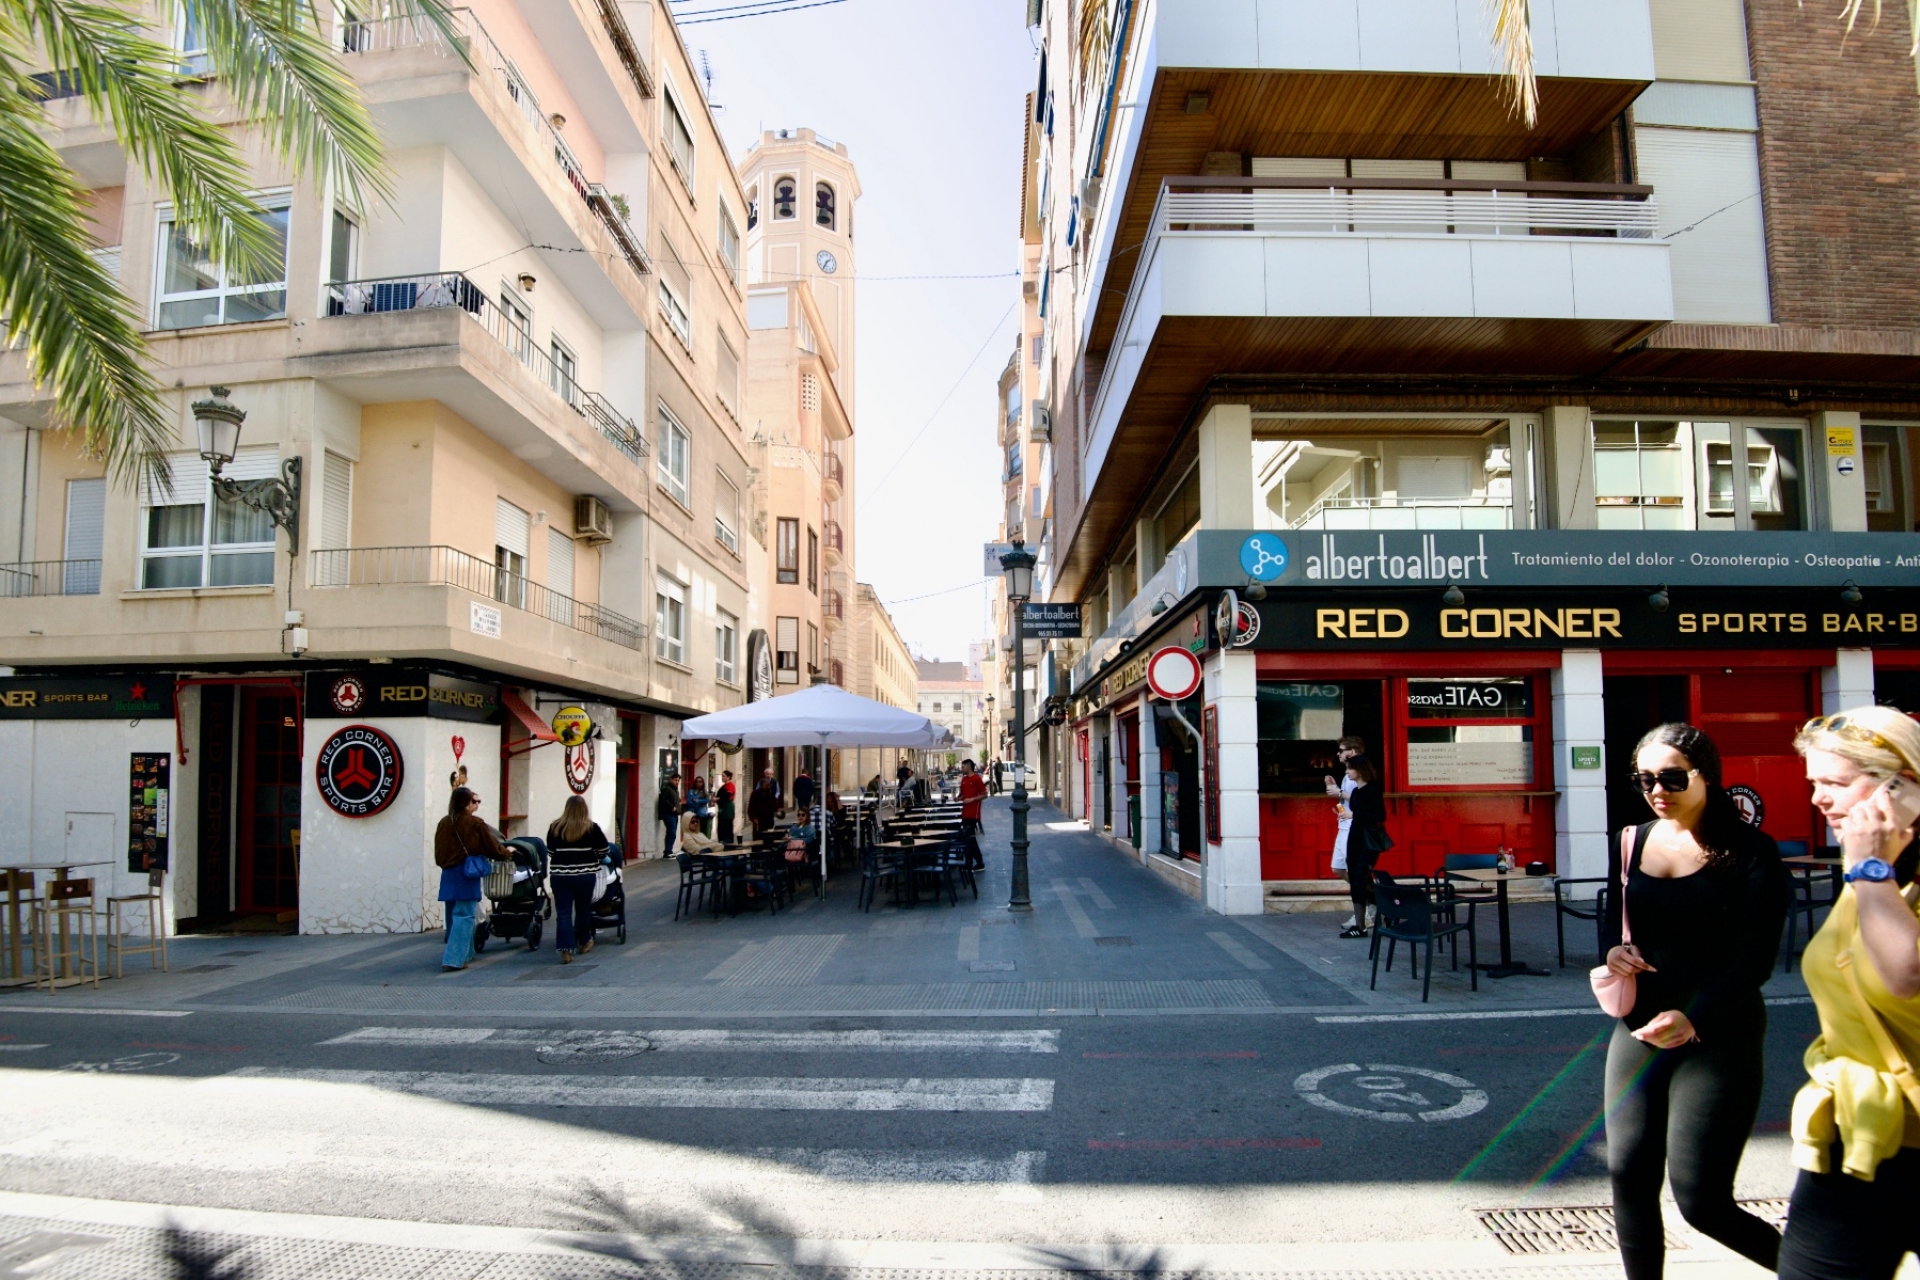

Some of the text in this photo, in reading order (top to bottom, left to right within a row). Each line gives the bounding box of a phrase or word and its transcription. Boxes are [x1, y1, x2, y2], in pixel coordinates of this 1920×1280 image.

[1306, 534, 1489, 580] albertoalbert
[1512, 552, 1603, 566] Tratamiento
[1612, 552, 1631, 566] del
[1635, 552, 1675, 567] dolor
[1690, 552, 1790, 570] Ozonoterapia
[1804, 553, 1881, 571] Osteopatía
[1316, 608, 1623, 639] RED CORNER
[1678, 612, 1919, 633] SPORTS BAR-B
[44, 693, 83, 703] SPORTS
[87, 694, 109, 702] BAR
[115, 700, 161, 712] Heineken
[380, 686, 428, 702] RED
[428, 687, 484, 709] CORNER
[321, 730, 393, 766] RED CORNER
[566, 764, 585, 791] SPORTS
[320, 776, 393, 814] SPORTS BAR
[1731, 787, 1761, 806] CORNER
